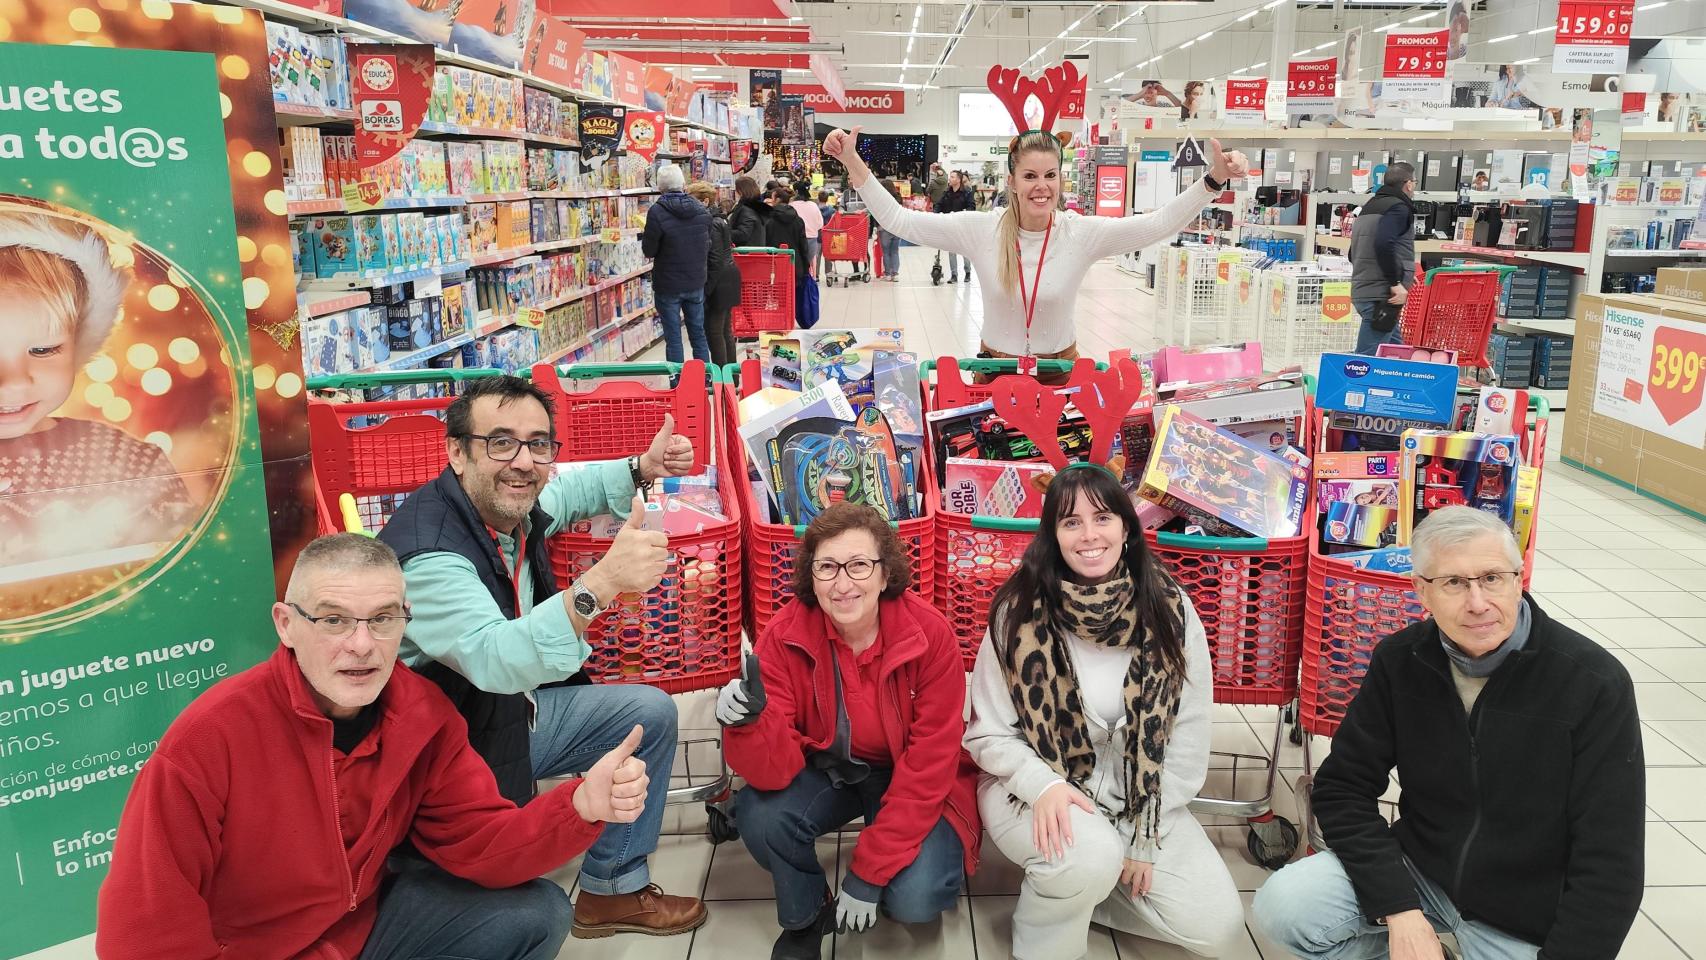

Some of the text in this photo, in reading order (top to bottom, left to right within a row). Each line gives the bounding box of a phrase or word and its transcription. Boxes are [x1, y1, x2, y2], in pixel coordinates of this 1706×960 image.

[1397, 37, 1438, 45] PROMOCIÓ
[368, 69, 387, 78] EDUCA
[1296, 63, 1329, 71] PROMOCIÓ
[0, 80, 123, 113] uetes
[843, 92, 893, 109] OMOCIÓ
[365, 115, 400, 124] BORRAS
[581, 118, 619, 130] MAGIA
[0, 126, 189, 168] a tod@s
[1664, 284, 1704, 300] Hisense
[389, 308, 409, 318] BINGO
[1606, 309, 1644, 328] Hisense
[1605, 325, 1613, 334] TV
[1346, 364, 1369, 372] vtech
[1411, 372, 1436, 380] camión
[799, 387, 825, 406] 1500
[1355, 415, 1397, 433] 1000
[1295, 482, 1306, 503] 1000
[20, 655, 130, 697] juguete
[135, 638, 215, 667] nuevo
[0, 662, 229, 726] emos a que llegue
[0, 732, 60, 758] iños.
[0, 770, 39, 789] ción
[44, 762, 67, 778] de
[72, 750, 121, 770] cómo
[56, 860, 79, 877] lo
